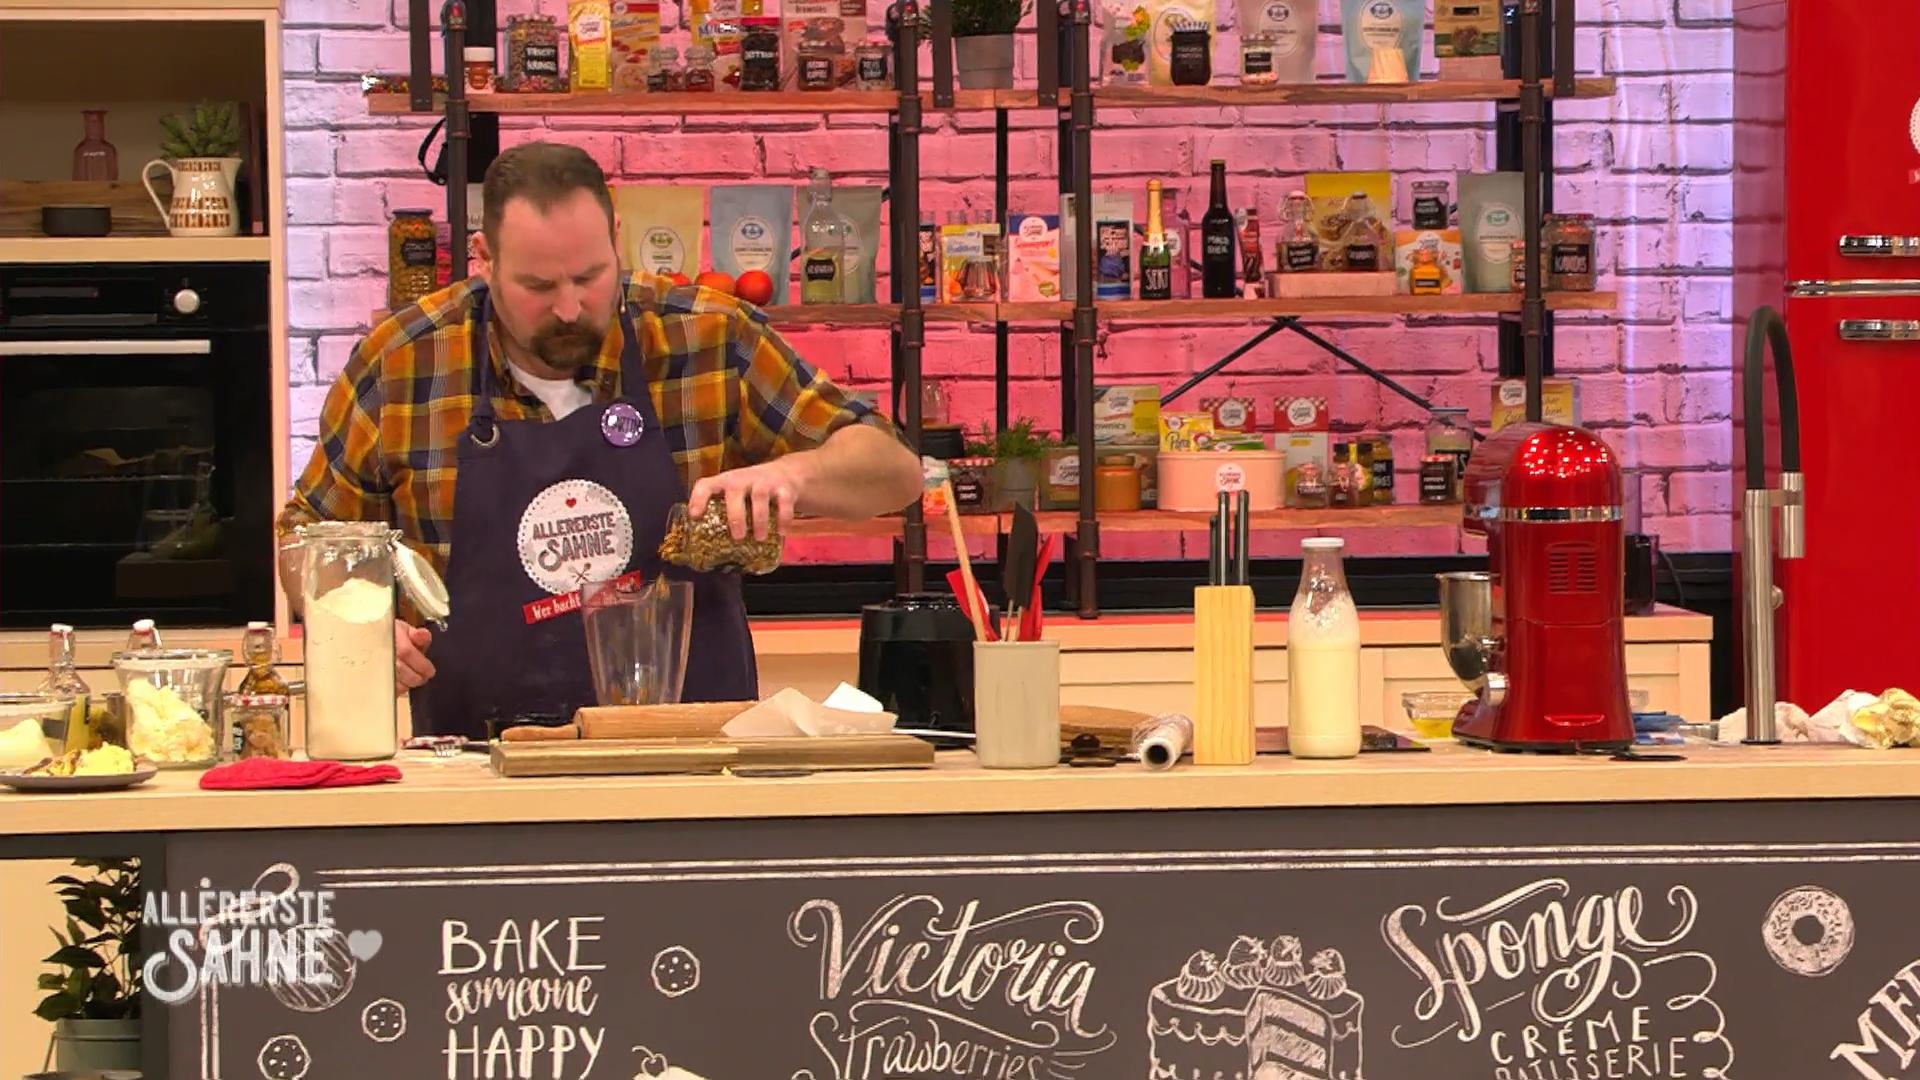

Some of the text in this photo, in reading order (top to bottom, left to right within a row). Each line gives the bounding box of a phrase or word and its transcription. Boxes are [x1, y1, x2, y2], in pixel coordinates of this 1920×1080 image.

[533, 511, 616, 540] ALLERERSTE
[538, 529, 615, 572] SAHNE
[532, 604, 552, 620] Wer
[438, 917, 606, 975] BAKE
[786, 894, 1106, 1038] Victoria
[1381, 878, 1698, 1042] Sponge
[445, 976, 599, 1023] someone
[441, 1025, 606, 1080] HAPPY
[1490, 1006, 1650, 1064] CRÉME
